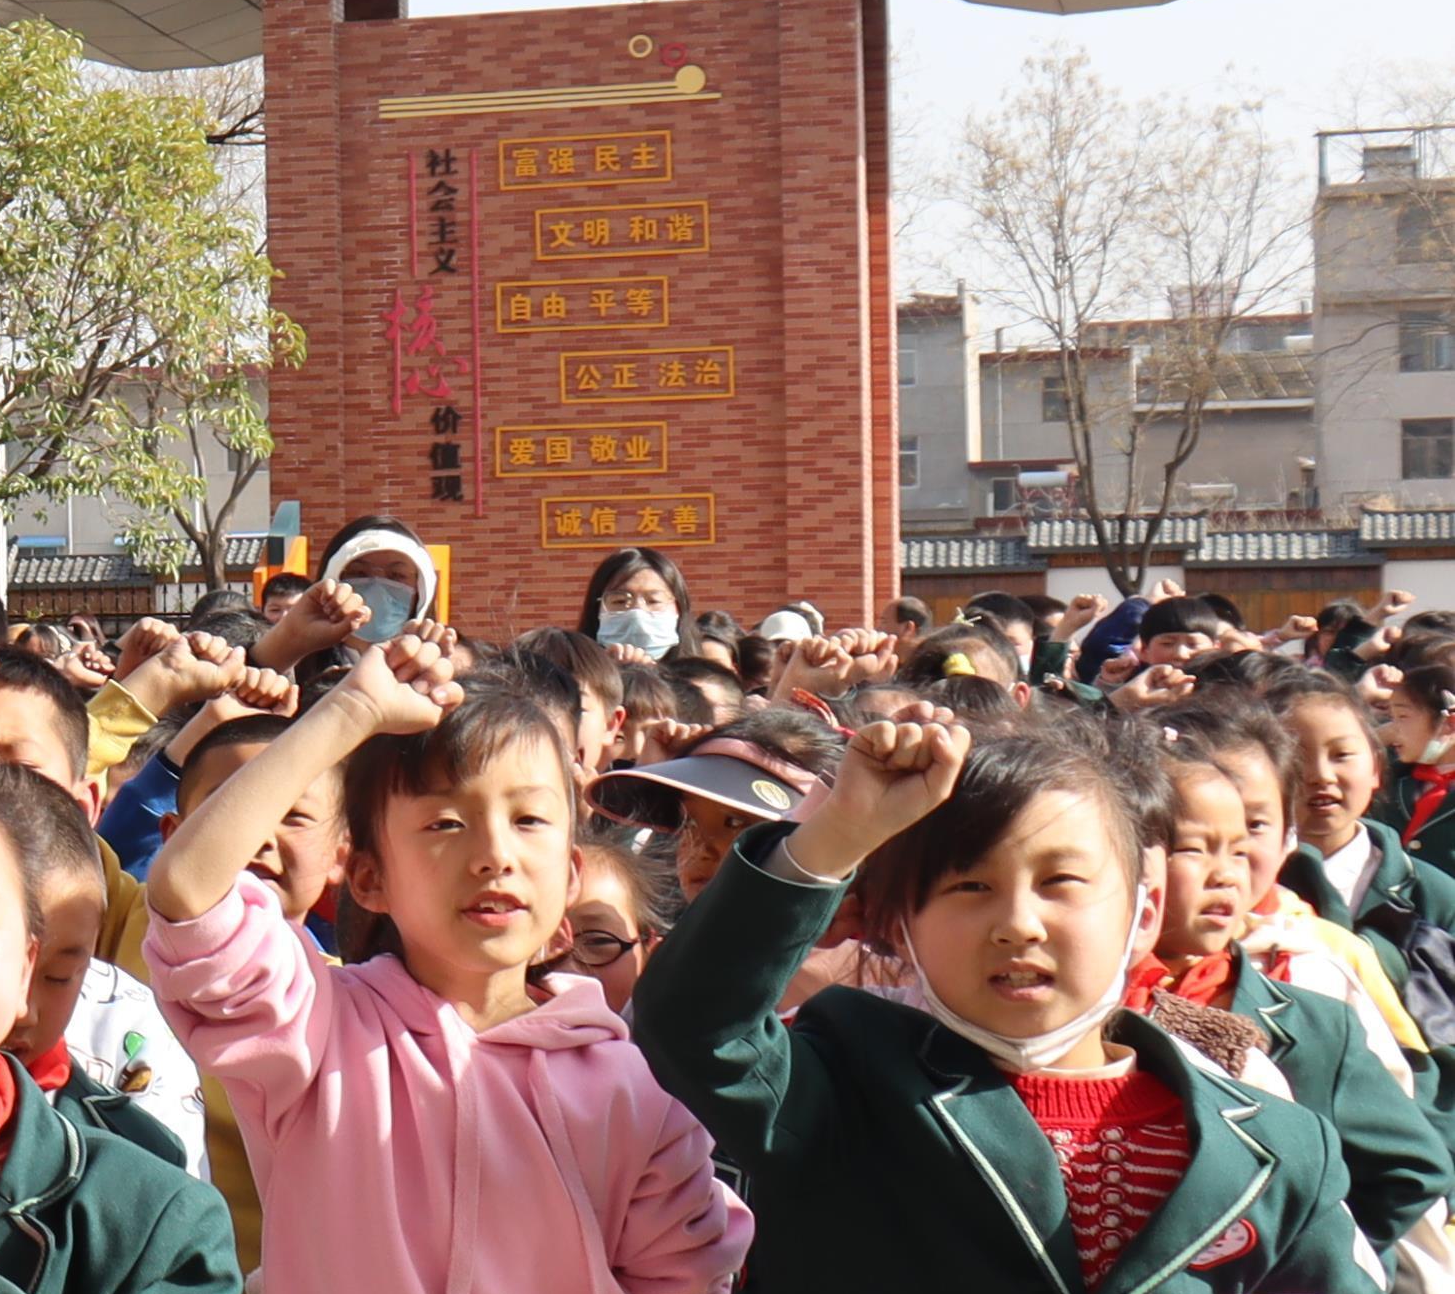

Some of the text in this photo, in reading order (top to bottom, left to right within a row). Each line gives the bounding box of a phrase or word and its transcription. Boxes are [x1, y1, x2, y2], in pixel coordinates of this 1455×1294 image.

[512, 142, 659, 177] 富强 民主
[427, 149, 458, 274] 社会主义
[549, 213, 695, 248] 文明 和谐
[510, 288, 654, 322] 自由 平等
[575, 359, 722, 391] 公正 法治
[429, 406, 463, 501] 价值观
[509, 434, 652, 466] 爱国 敬业
[555, 505, 700, 537] 诚信 友善
